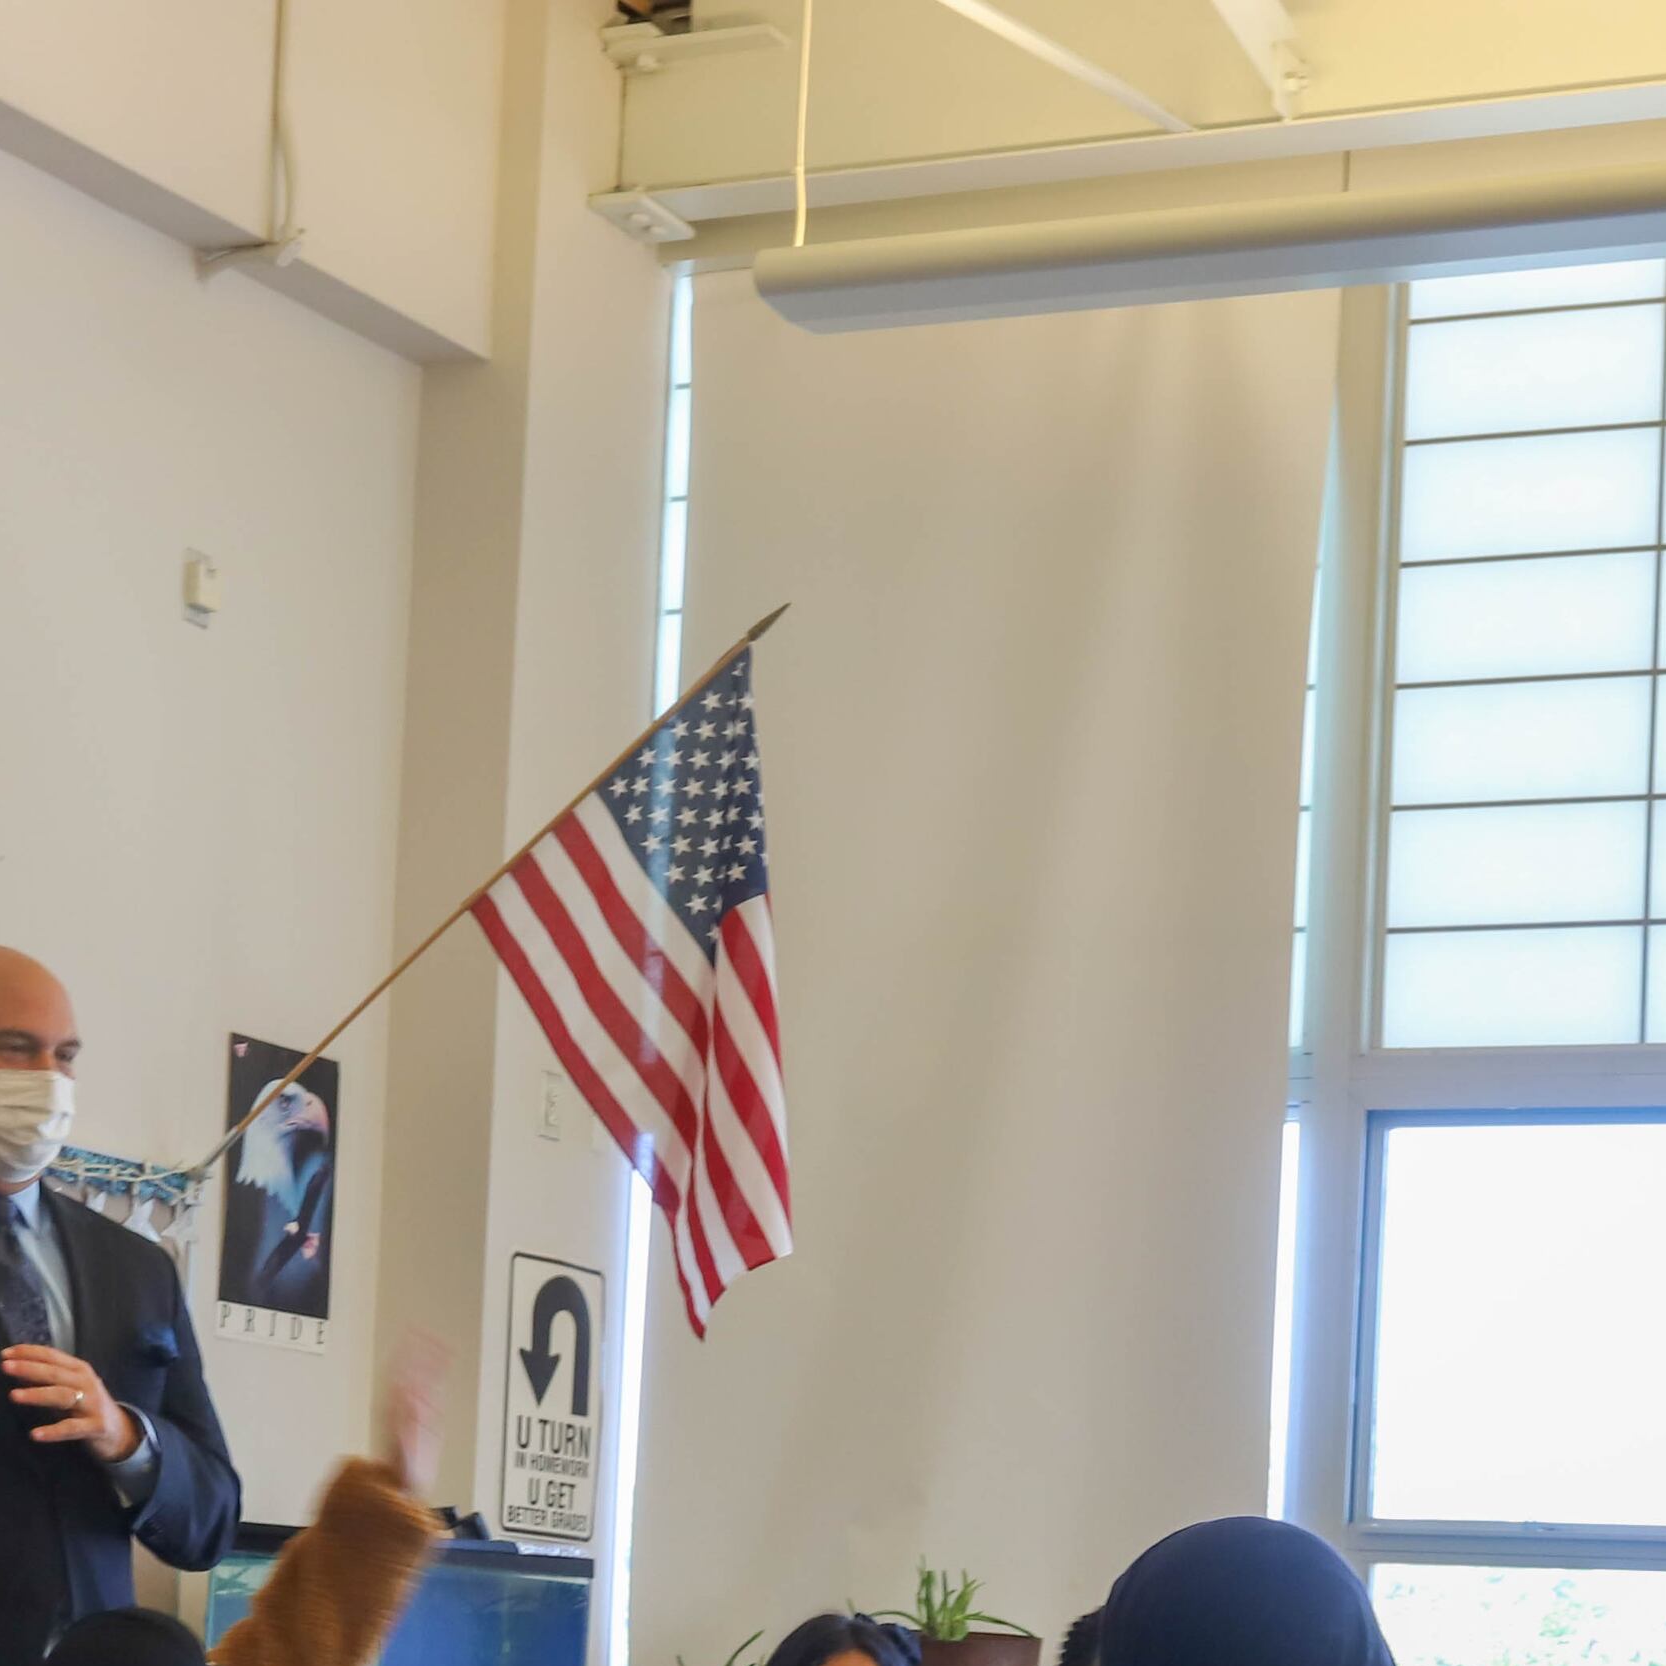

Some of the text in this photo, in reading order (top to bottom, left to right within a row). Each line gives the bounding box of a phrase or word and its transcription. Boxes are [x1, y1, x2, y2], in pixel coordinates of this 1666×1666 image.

[219, 1303, 325, 1345] PRIDE
[517, 1414, 592, 1458] U TURN
[514, 1450, 590, 1479] IN HOMEWORK
[528, 1477, 576, 1510] U GET
[507, 1505, 547, 1526] BETTER
